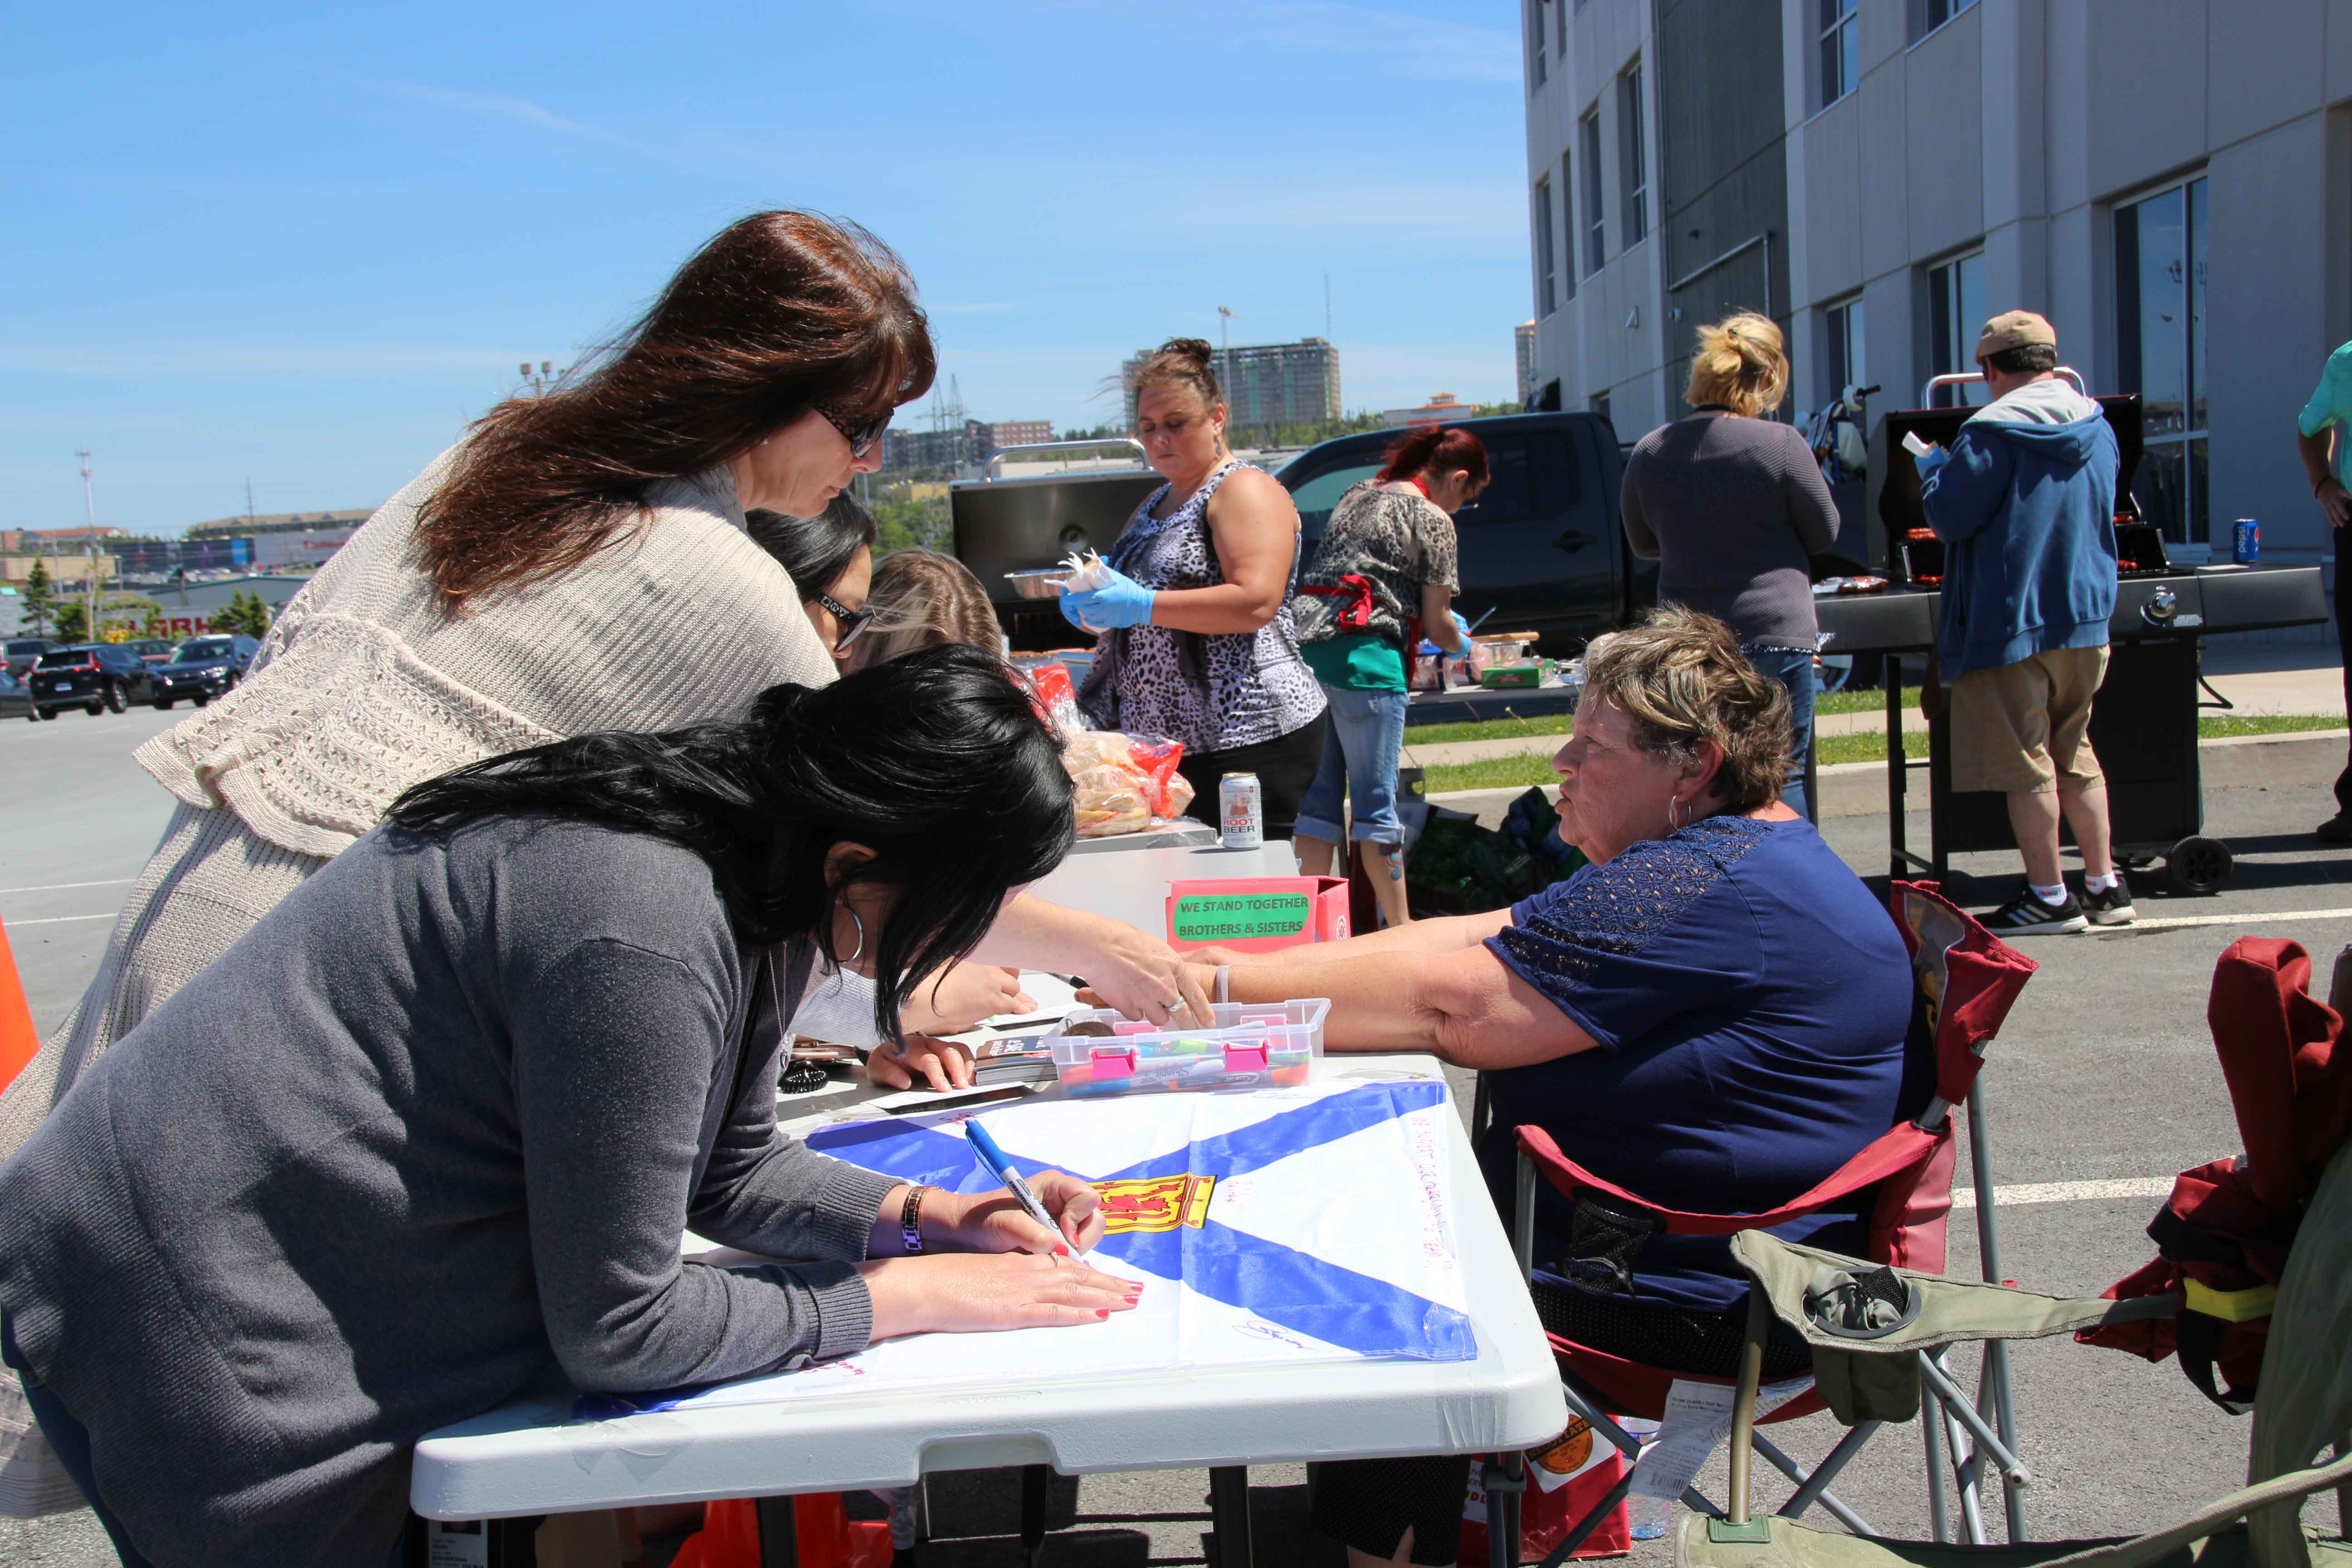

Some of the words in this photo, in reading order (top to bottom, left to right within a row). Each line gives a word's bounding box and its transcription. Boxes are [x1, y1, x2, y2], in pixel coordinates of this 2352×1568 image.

[2237, 527, 2247, 553] pepsi
[1180, 902, 1200, 912] WE
[1203, 901, 1243, 911] STAND
[1246, 897, 1308, 910] TOGETHER
[1180, 923, 1241, 936] BROTHERS
[1245, 923, 1254, 933] &
[1257, 921, 1303, 933] SISTERS
